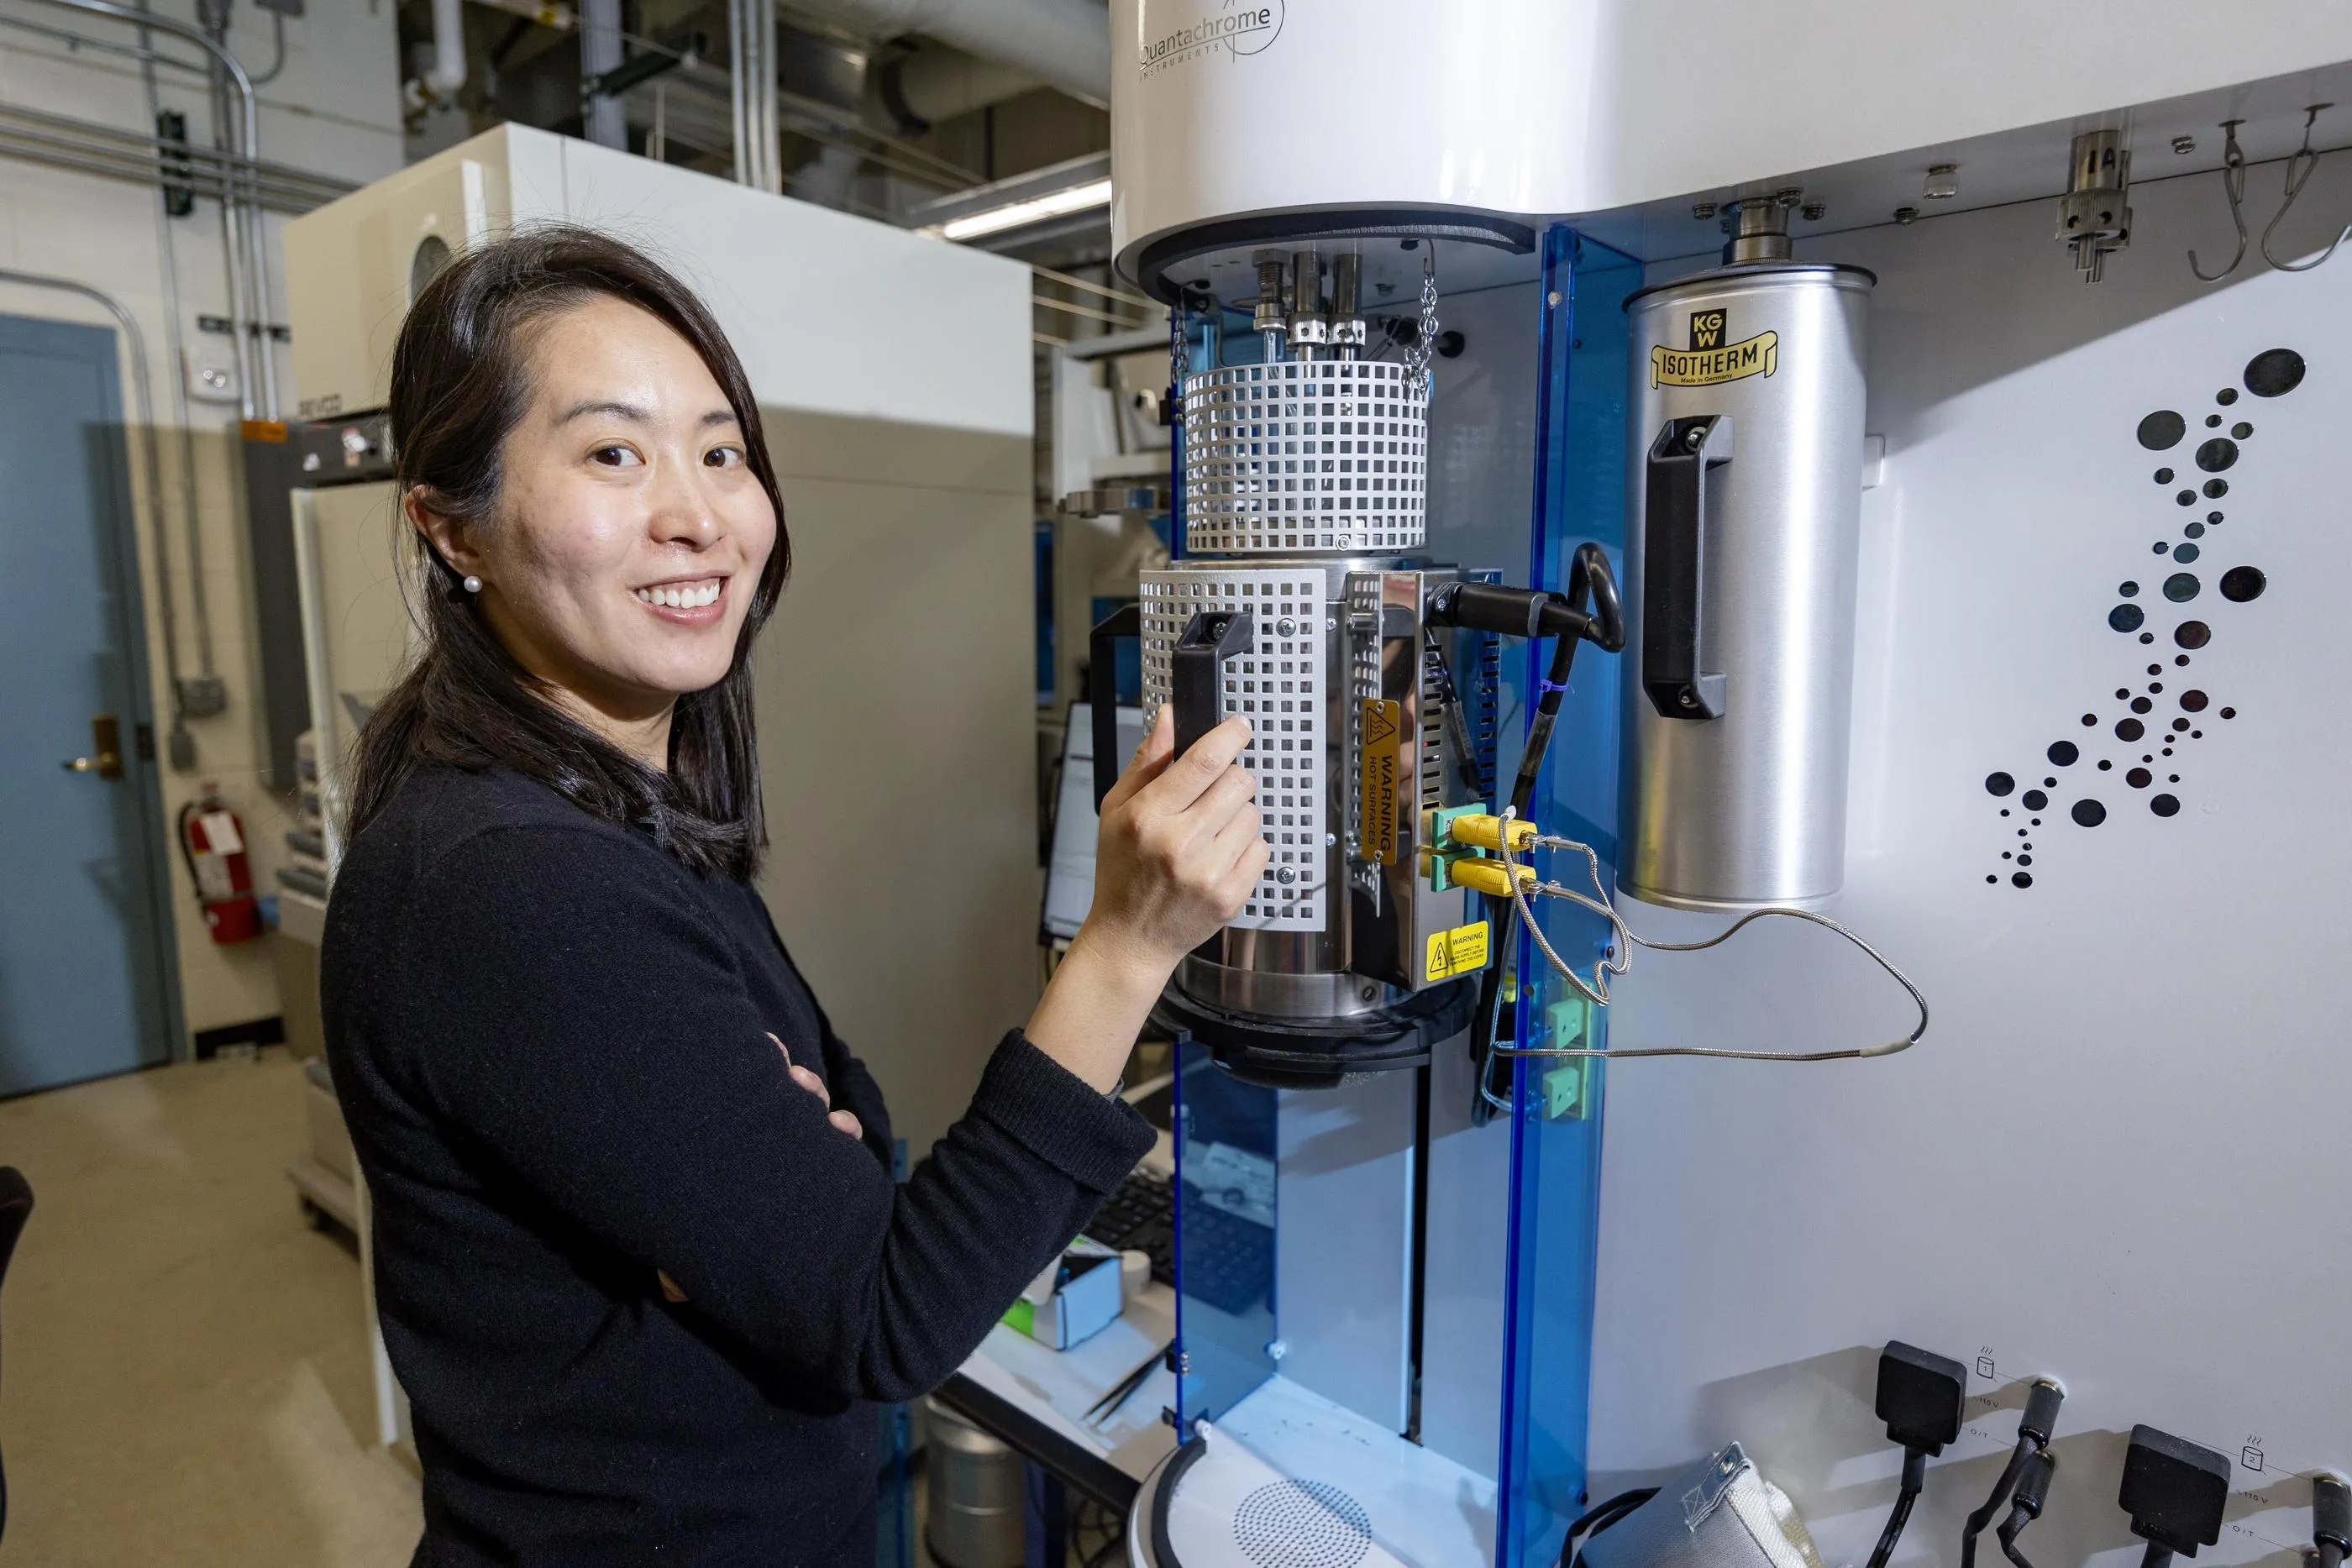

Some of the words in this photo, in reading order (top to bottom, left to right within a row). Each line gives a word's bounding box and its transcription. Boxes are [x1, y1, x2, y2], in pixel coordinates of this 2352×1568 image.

[1139, 8, 1271, 65] Quantachrome
[1139, 43, 1220, 81] INSTRUMENTS
[1693, 313, 1723, 333] KG
[1697, 330, 1718, 348] W
[1662, 343, 1758, 375] ISOTHERM
[1704, 373, 1733, 382] Germany
[1368, 756, 1377, 779] HOT
[1368, 785, 1377, 846] SURFACES
[1380, 755, 1393, 852] WARNING
[1452, 931, 1483, 946] WARNING
